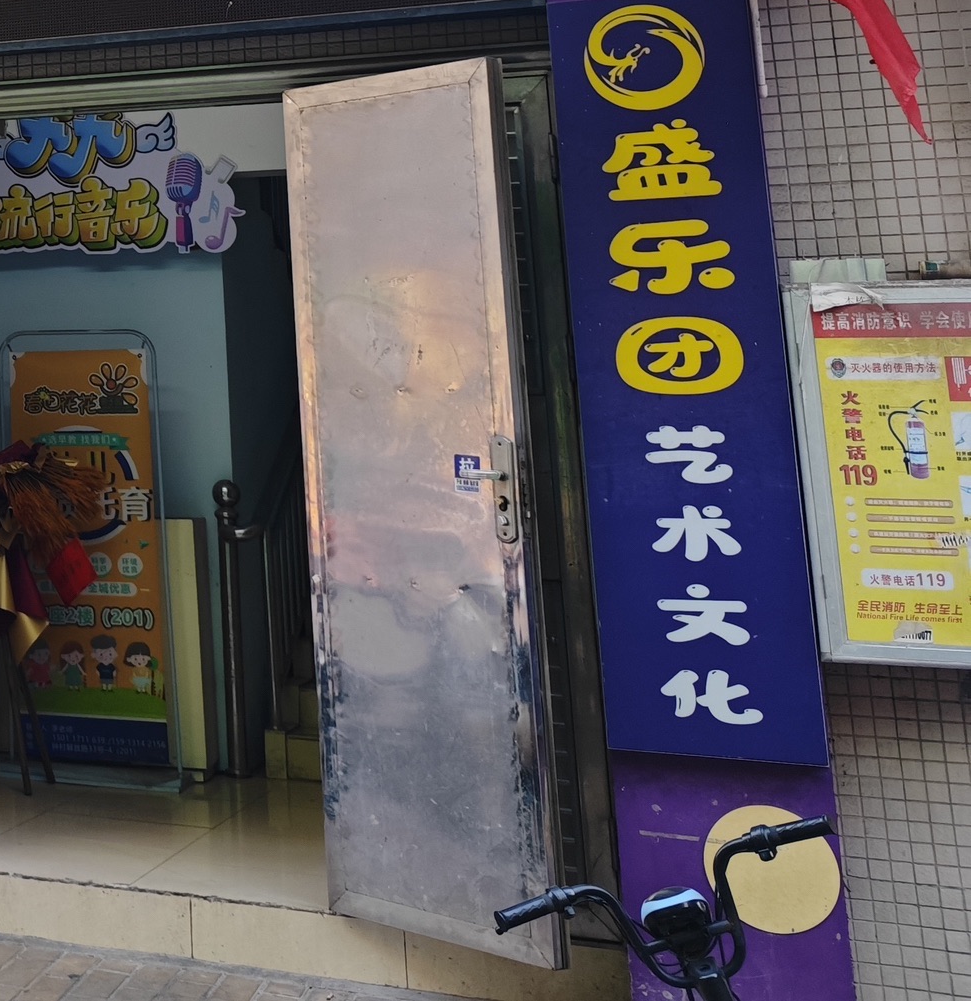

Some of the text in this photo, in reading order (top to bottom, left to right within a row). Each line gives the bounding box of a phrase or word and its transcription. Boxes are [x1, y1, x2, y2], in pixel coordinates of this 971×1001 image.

[601, 118, 744, 395] 盛乐团
[821, 310, 971, 330] 提高消防意识 学会使
[850, 362, 936, 373] 灭火器的使用方法
[841, 391, 867, 461] 火警电话
[839, 464, 878, 487] 119
[646, 425, 763, 725] 艺术文化
[870, 573, 945, 587] 火警电话119
[47, 605, 95, 626] 座2楼
[856, 612, 888, 620] National
[857, 600, 963, 616] 全民消防 生命至上
